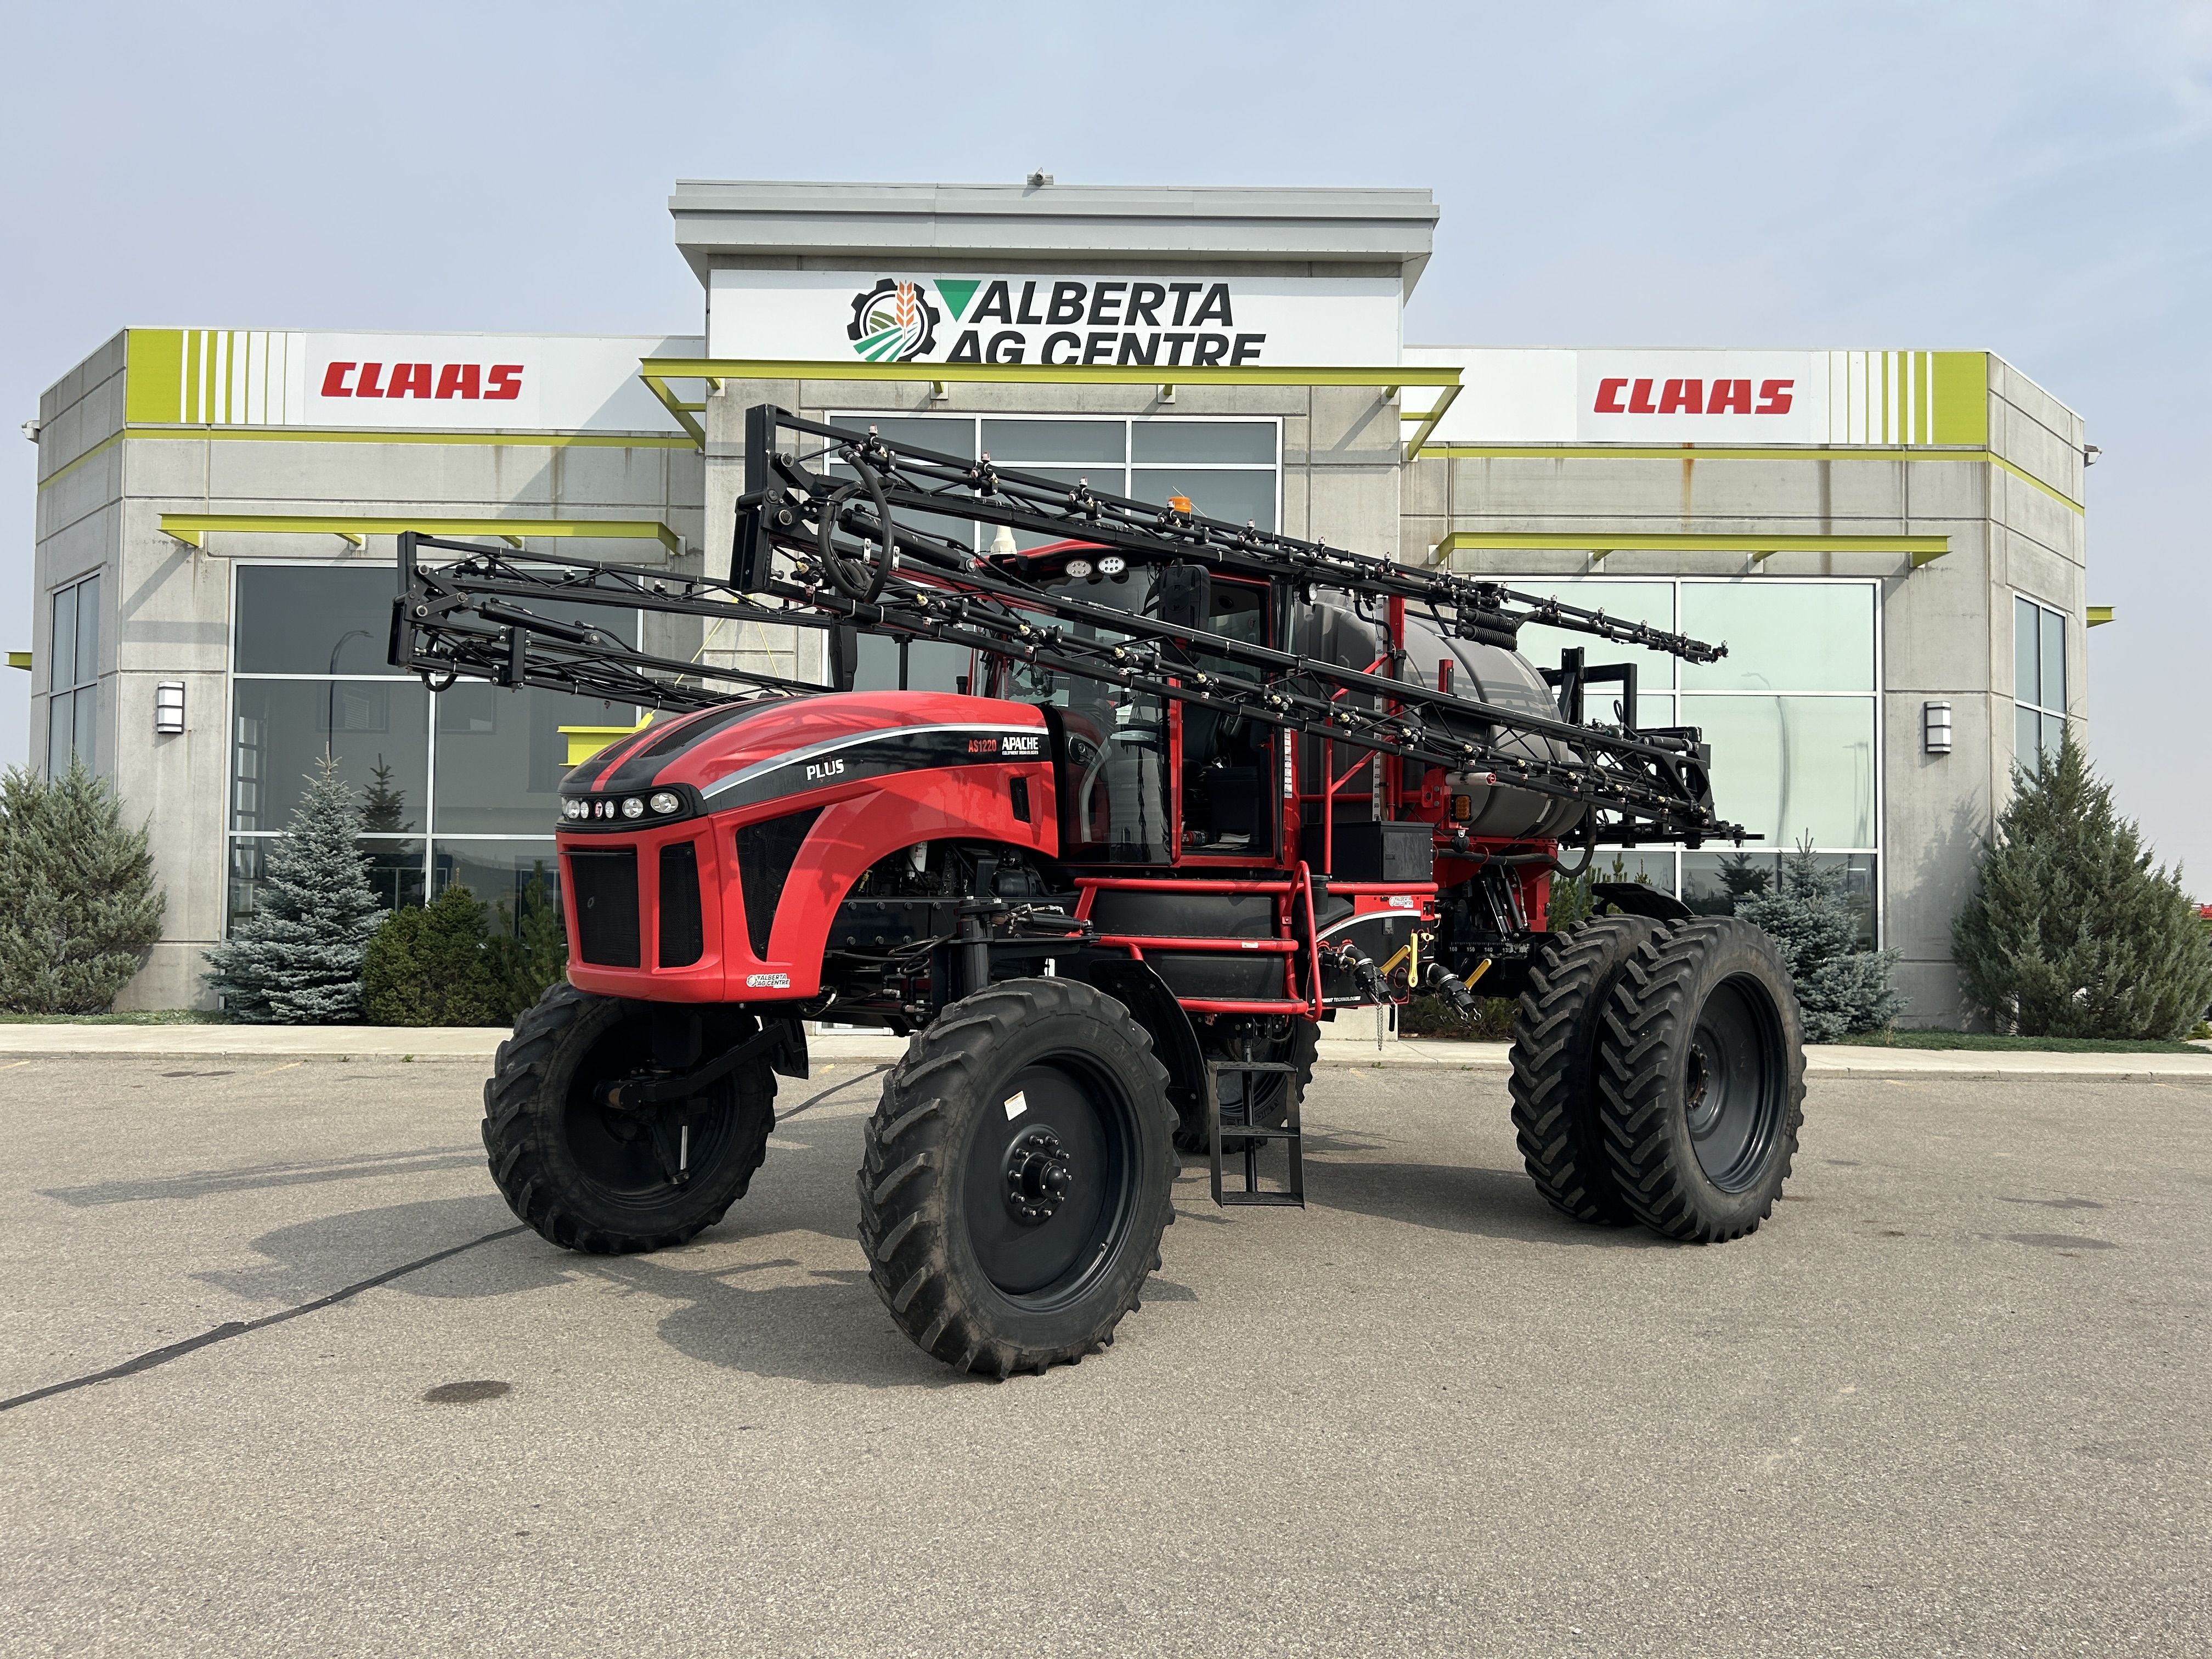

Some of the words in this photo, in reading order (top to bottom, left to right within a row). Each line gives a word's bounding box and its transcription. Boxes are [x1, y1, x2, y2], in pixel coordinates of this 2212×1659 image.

[968, 280, 1233, 327] ALBERTA
[945, 330, 1025, 364] AG
[1041, 331, 1266, 366] CENTRE
[321, 362, 524, 400] CLAAS
[1593, 377, 1795, 415] CLAAS
[968, 740, 997, 753] AS1220
[1002, 737, 1039, 751] APACHE
[806, 759, 844, 781] PLUS
